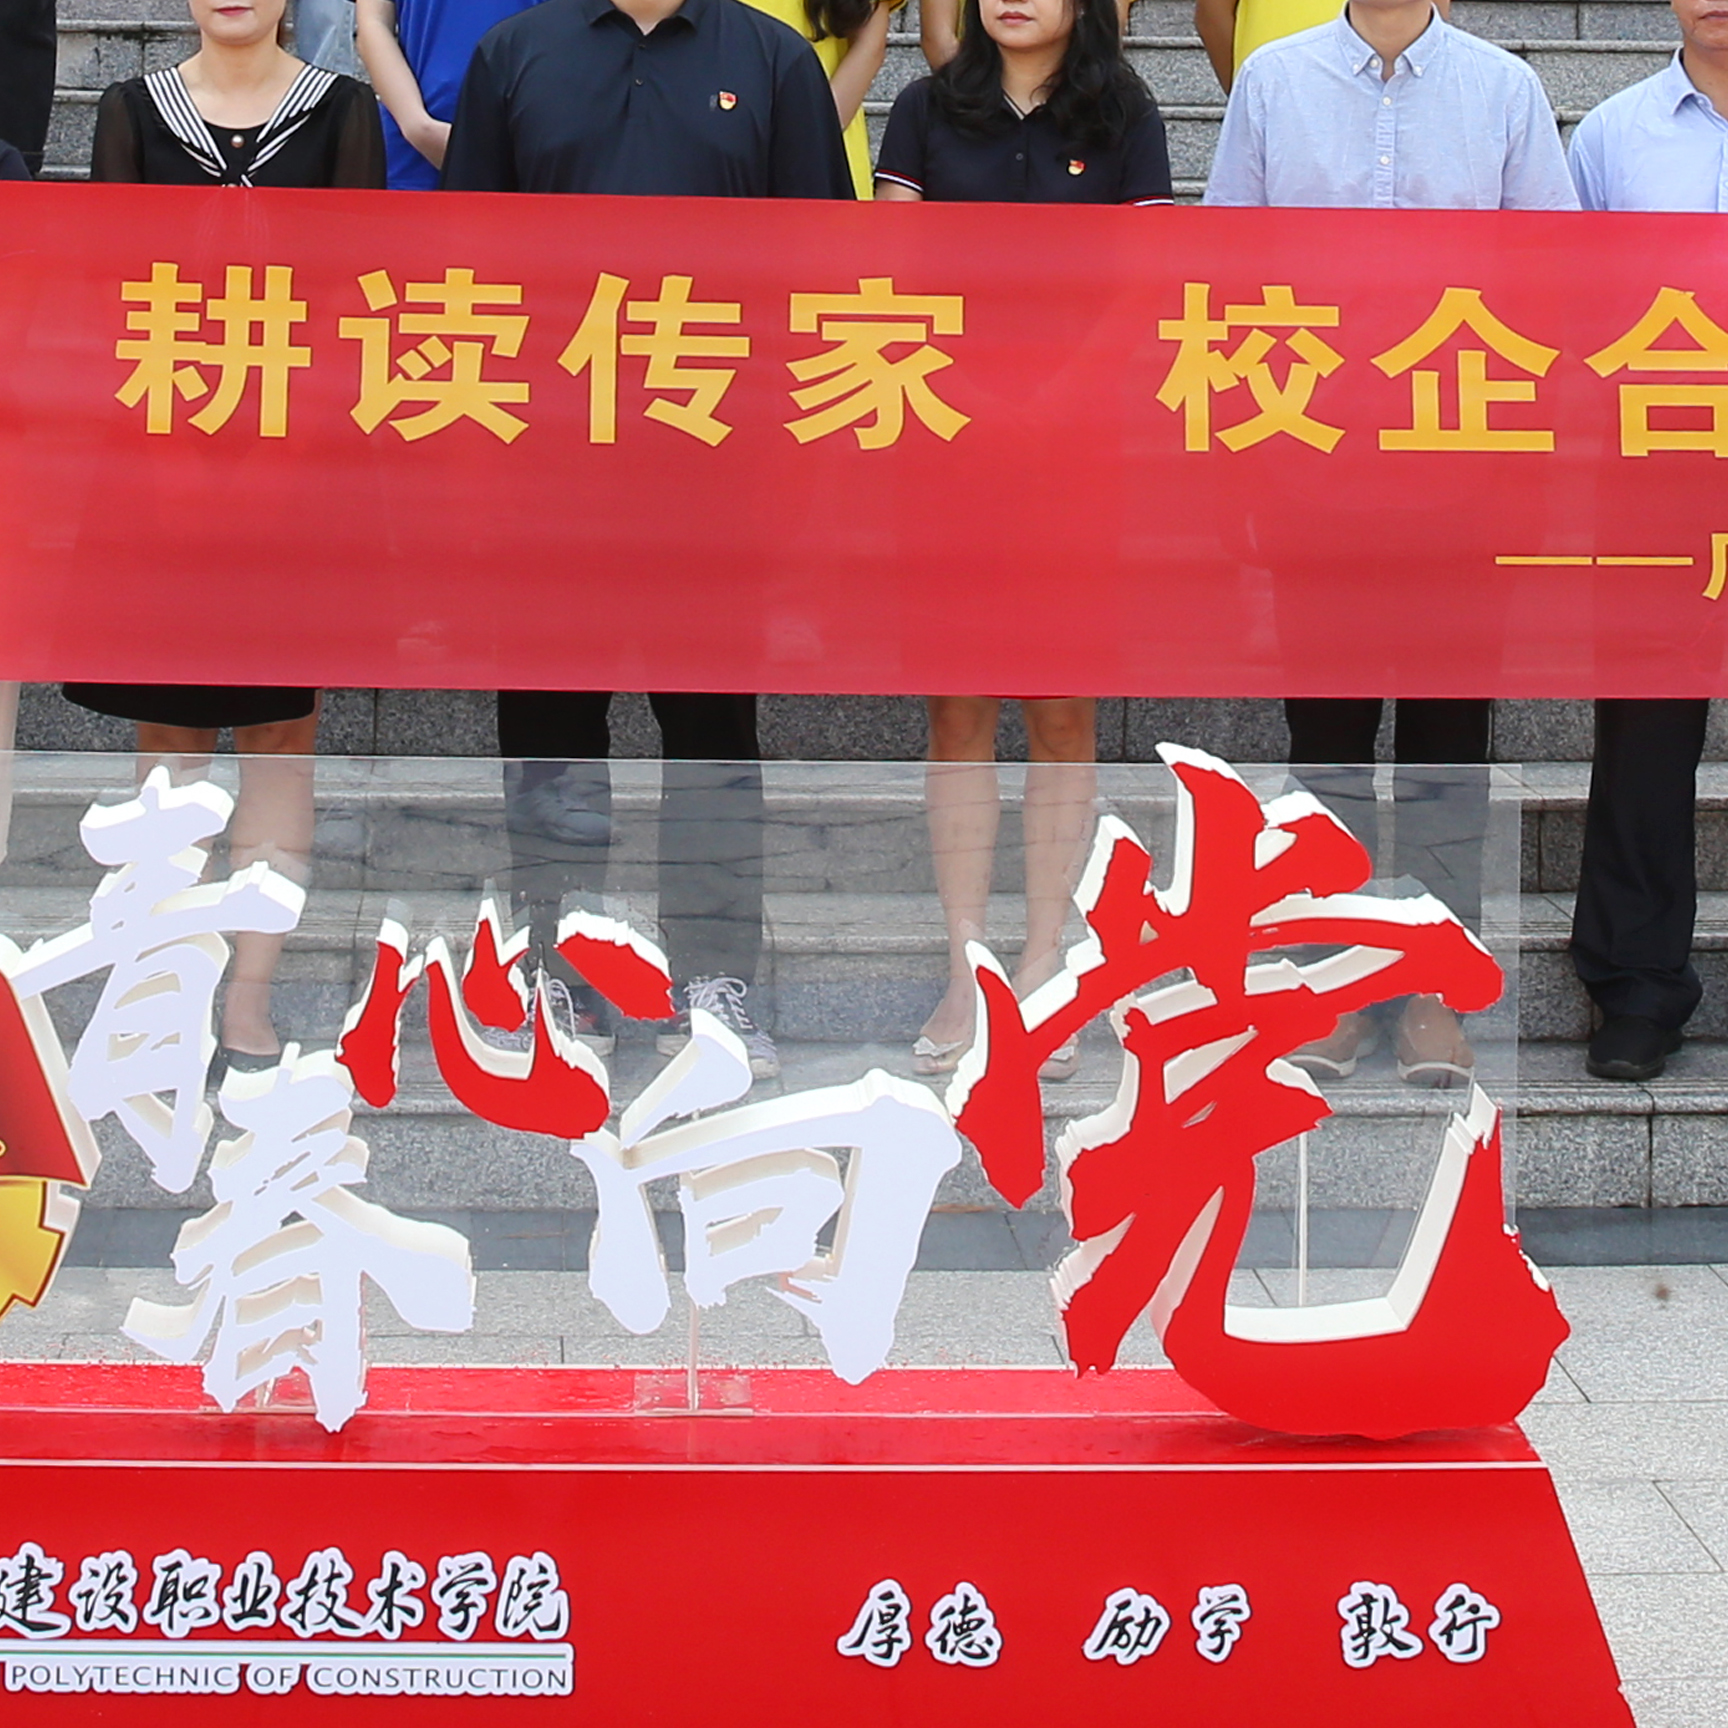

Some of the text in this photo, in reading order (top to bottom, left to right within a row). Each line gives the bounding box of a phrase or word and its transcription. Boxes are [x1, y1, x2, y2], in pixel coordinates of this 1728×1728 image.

[115, 261, 971, 450] 耕读传家
[846, 1587, 998, 1662] 厚德
[1089, 1591, 1246, 1660] 励学
[1345, 1589, 1496, 1662] 敦行
[11, 1662, 235, 1689] POLYTECHNIC
[254, 1662, 297, 1689] OF
[314, 1662, 569, 1690] CONSTRUCTION
